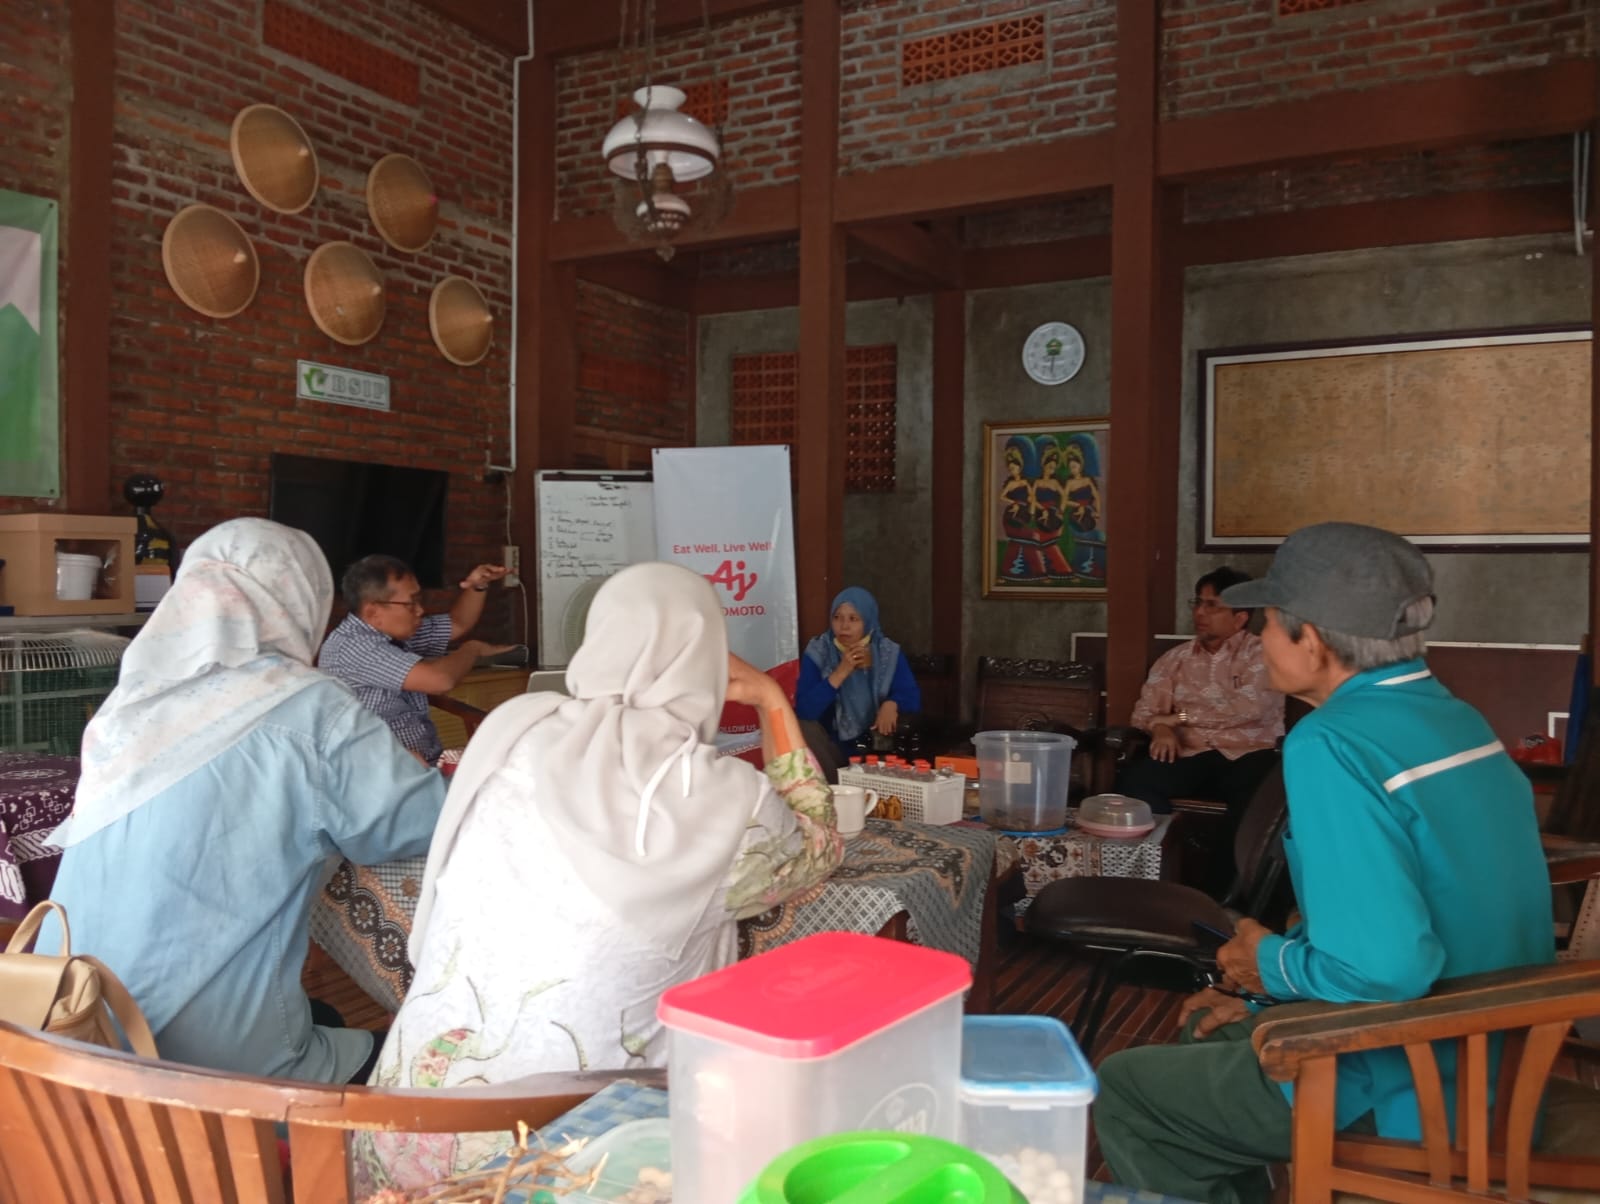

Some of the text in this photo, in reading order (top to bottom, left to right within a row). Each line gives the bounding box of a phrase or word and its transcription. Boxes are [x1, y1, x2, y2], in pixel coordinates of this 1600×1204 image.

[673, 544, 691, 554] Eat
[723, 543, 746, 553] Live
[722, 605, 765, 616] OMOTO
